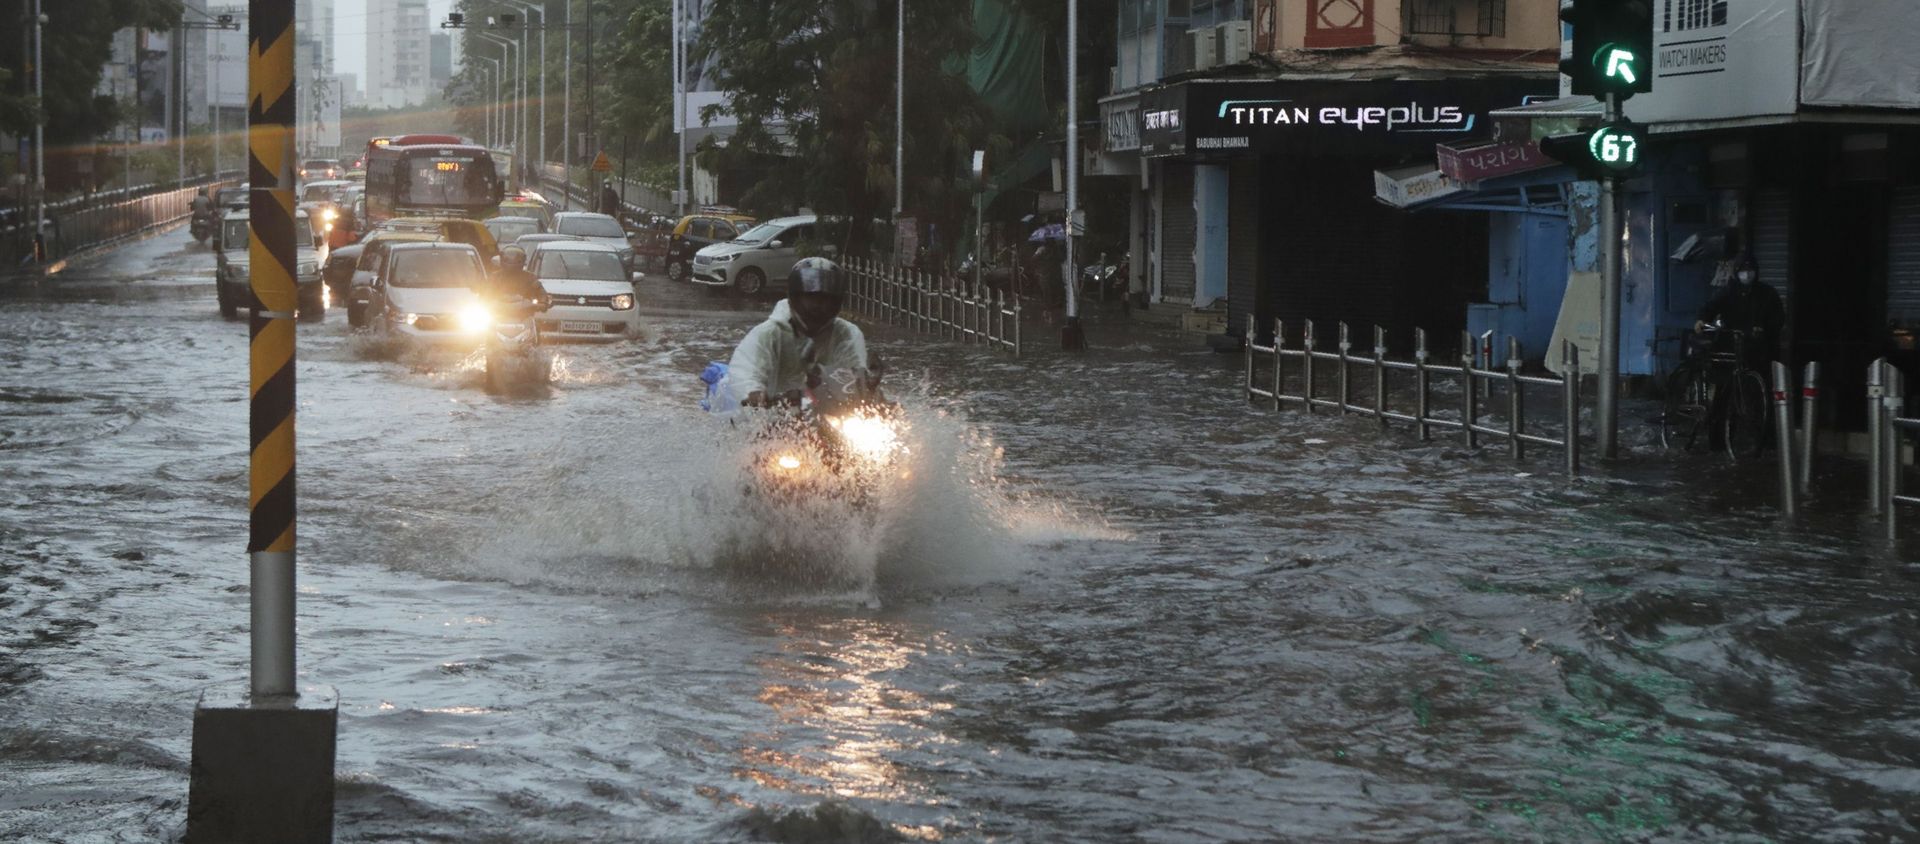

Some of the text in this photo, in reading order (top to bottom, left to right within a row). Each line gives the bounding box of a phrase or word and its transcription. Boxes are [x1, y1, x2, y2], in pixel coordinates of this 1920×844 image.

[1659, 44, 1726, 68] WATCH MAKERS
[1231, 101, 1463, 131] TITAN eyeplus
[1602, 134, 1636, 162] 67
